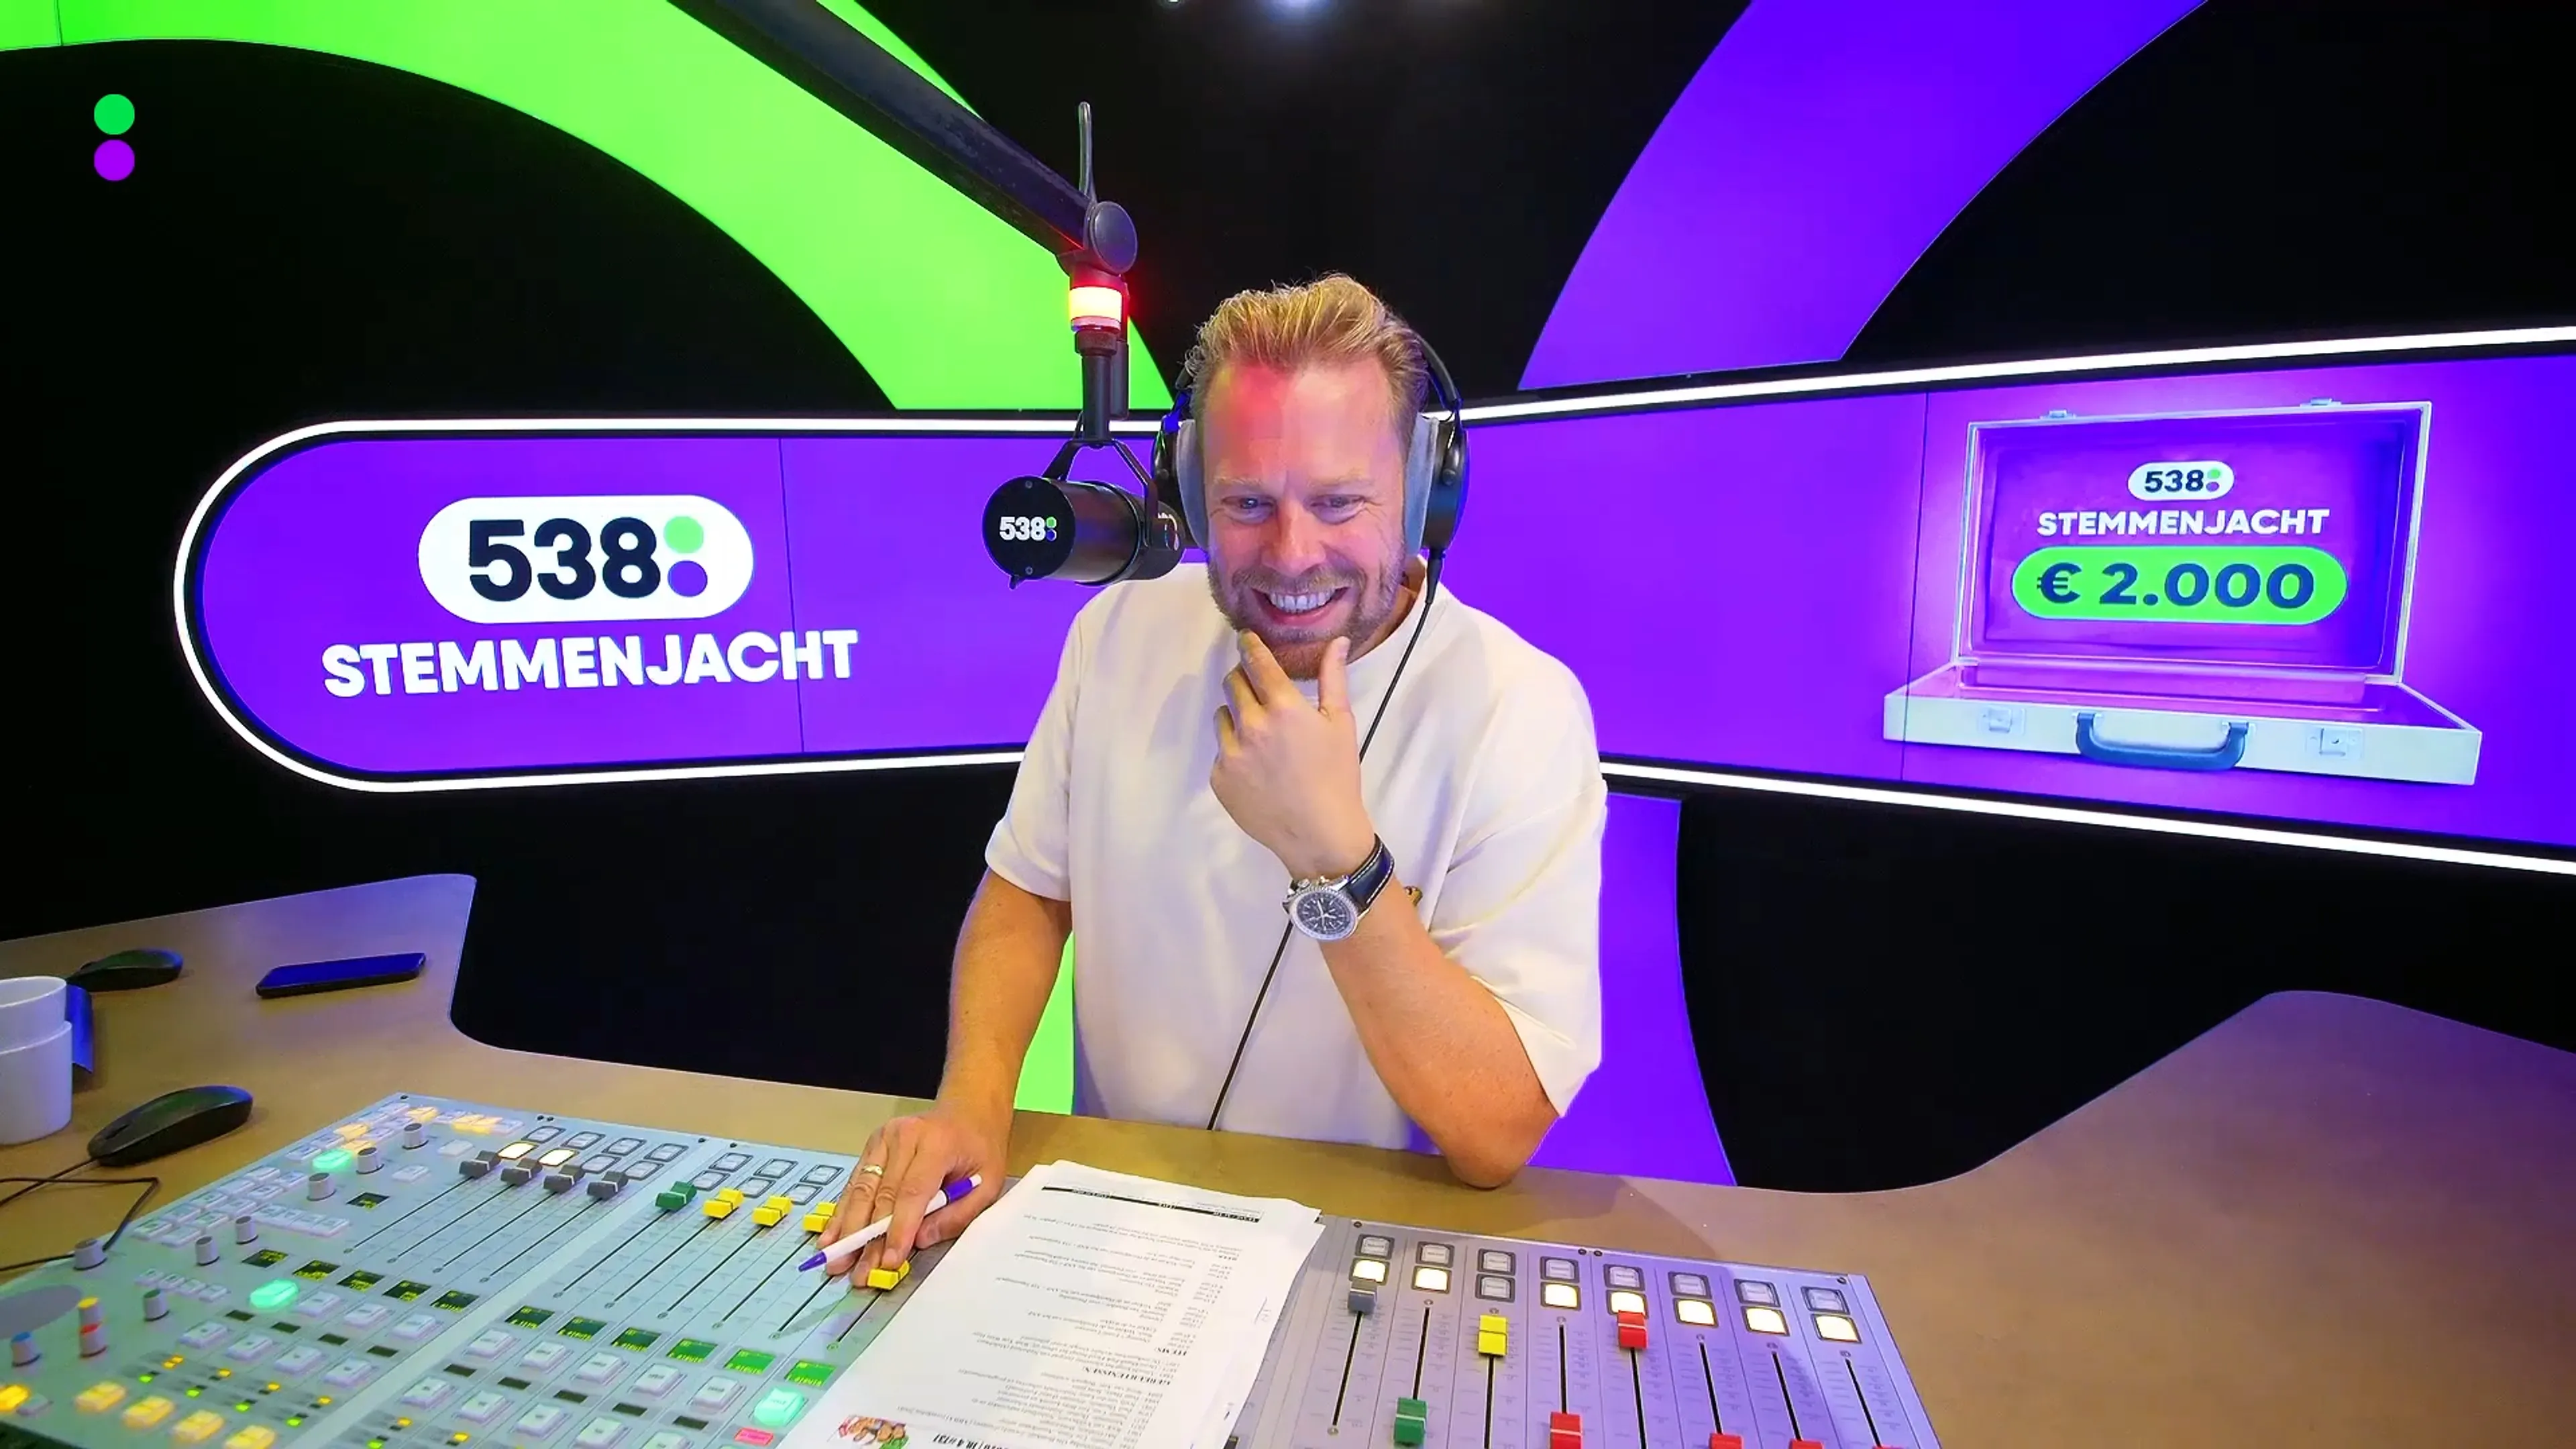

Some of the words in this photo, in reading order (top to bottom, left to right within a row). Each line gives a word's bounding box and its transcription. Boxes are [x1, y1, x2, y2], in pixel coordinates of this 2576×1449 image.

[2145, 470, 2205, 493] 538
[1000, 516, 1046, 541] 538
[2037, 509, 2330, 536] STEMMENJACHT
[468, 517, 661, 602] 538
[2099, 562, 2315, 609] 2.000
[321, 629, 859, 698] STEMMENJACHT
